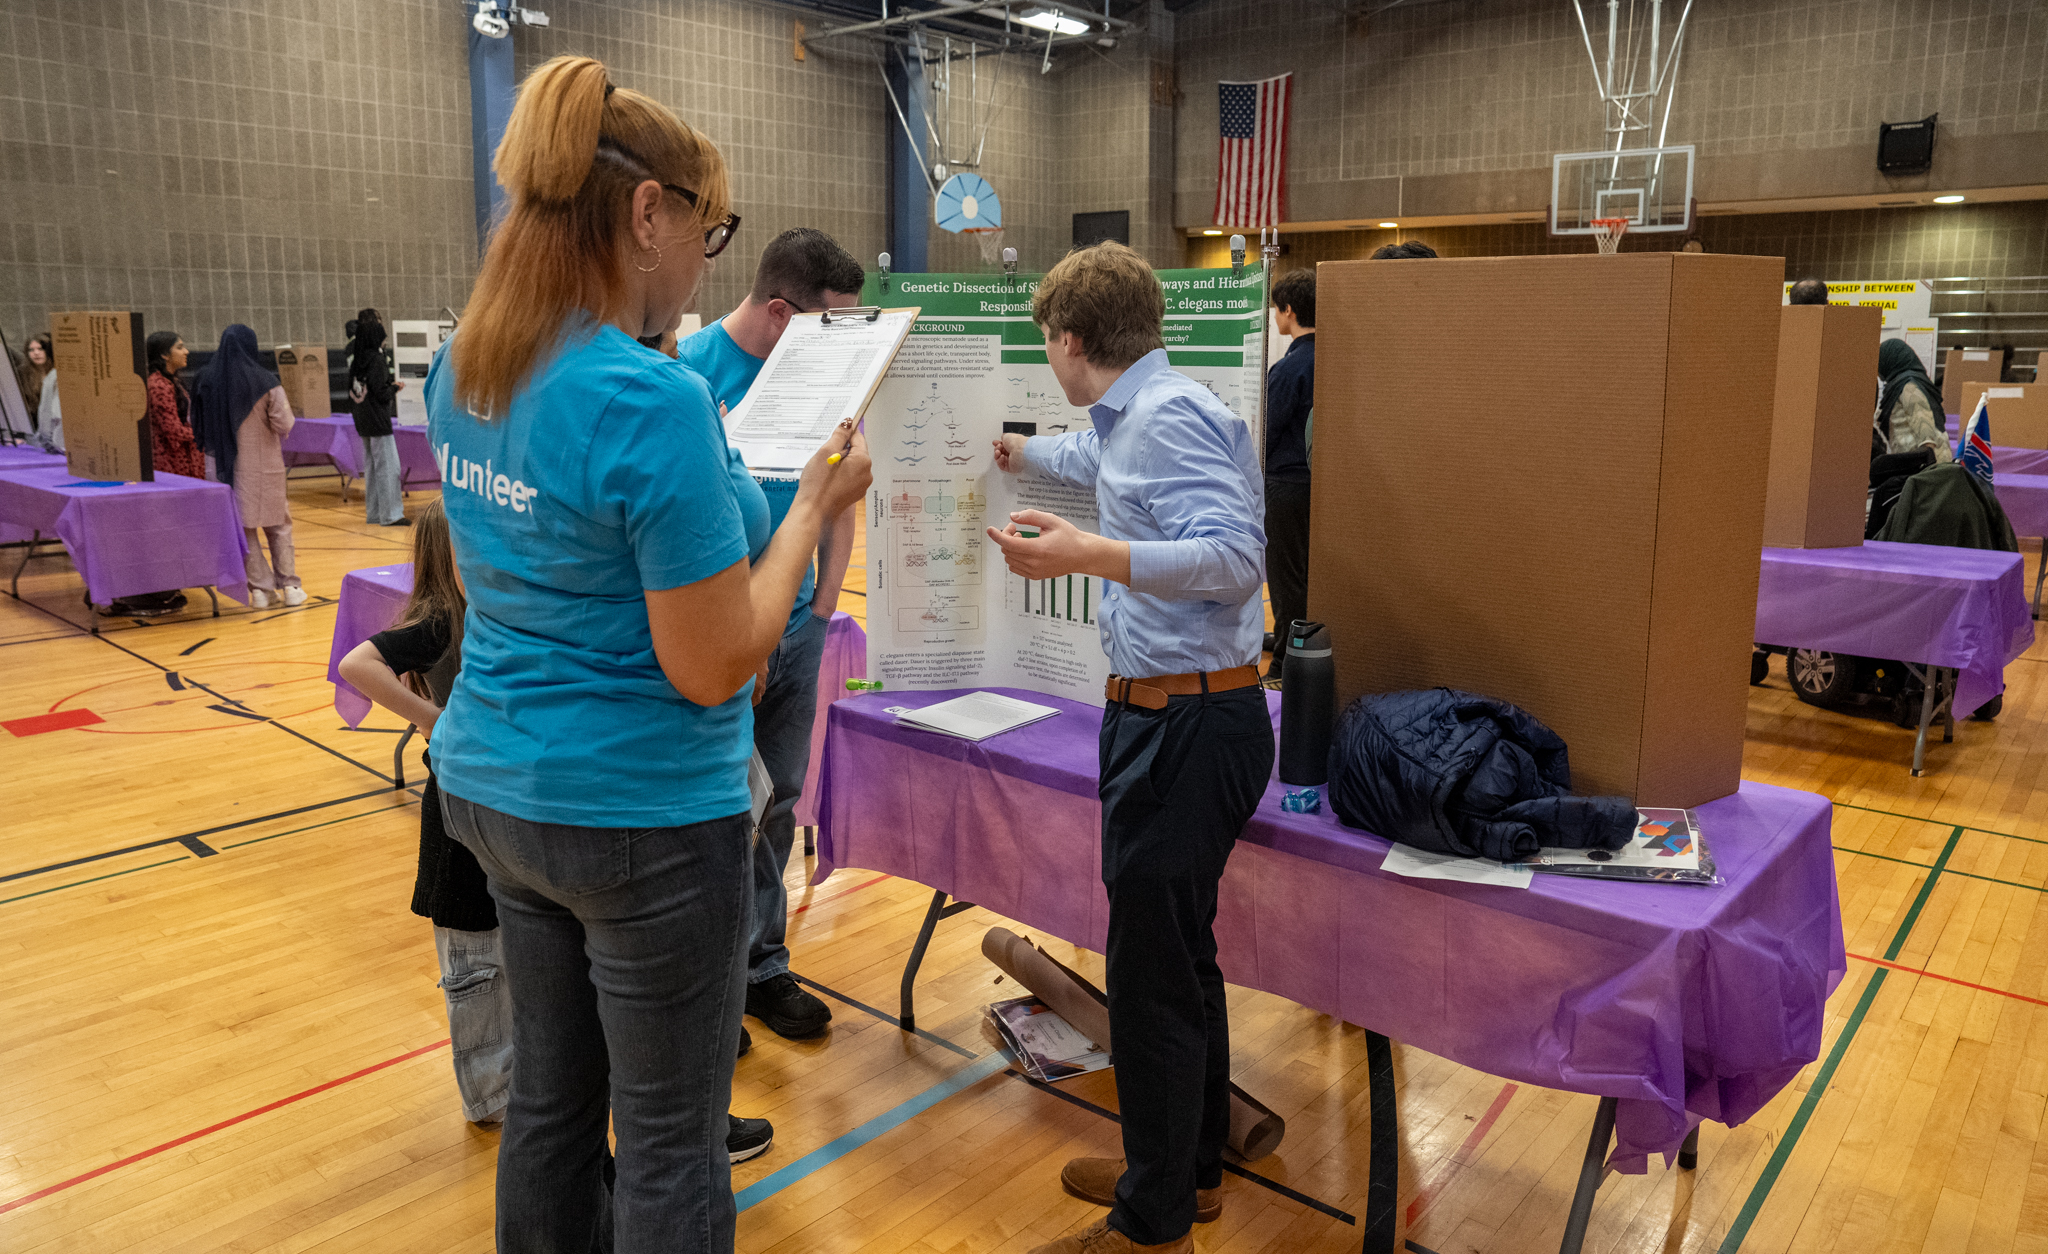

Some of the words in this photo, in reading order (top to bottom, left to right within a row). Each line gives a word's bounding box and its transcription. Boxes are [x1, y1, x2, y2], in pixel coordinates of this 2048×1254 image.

[901, 282, 949, 293] Genetic
[953, 282, 1014, 293] Dissection
[1017, 282, 1026, 293] of
[1162, 280, 1190, 293] ways
[1193, 277, 1215, 289] and
[1864, 284, 1914, 292] BETWEEN
[980, 301, 1034, 314] Responsib
[1165, 298, 1175, 309] C.
[1178, 297, 1223, 312] elegans
[911, 323, 965, 332] CKGROUND
[436, 442, 538, 516] lunteer
